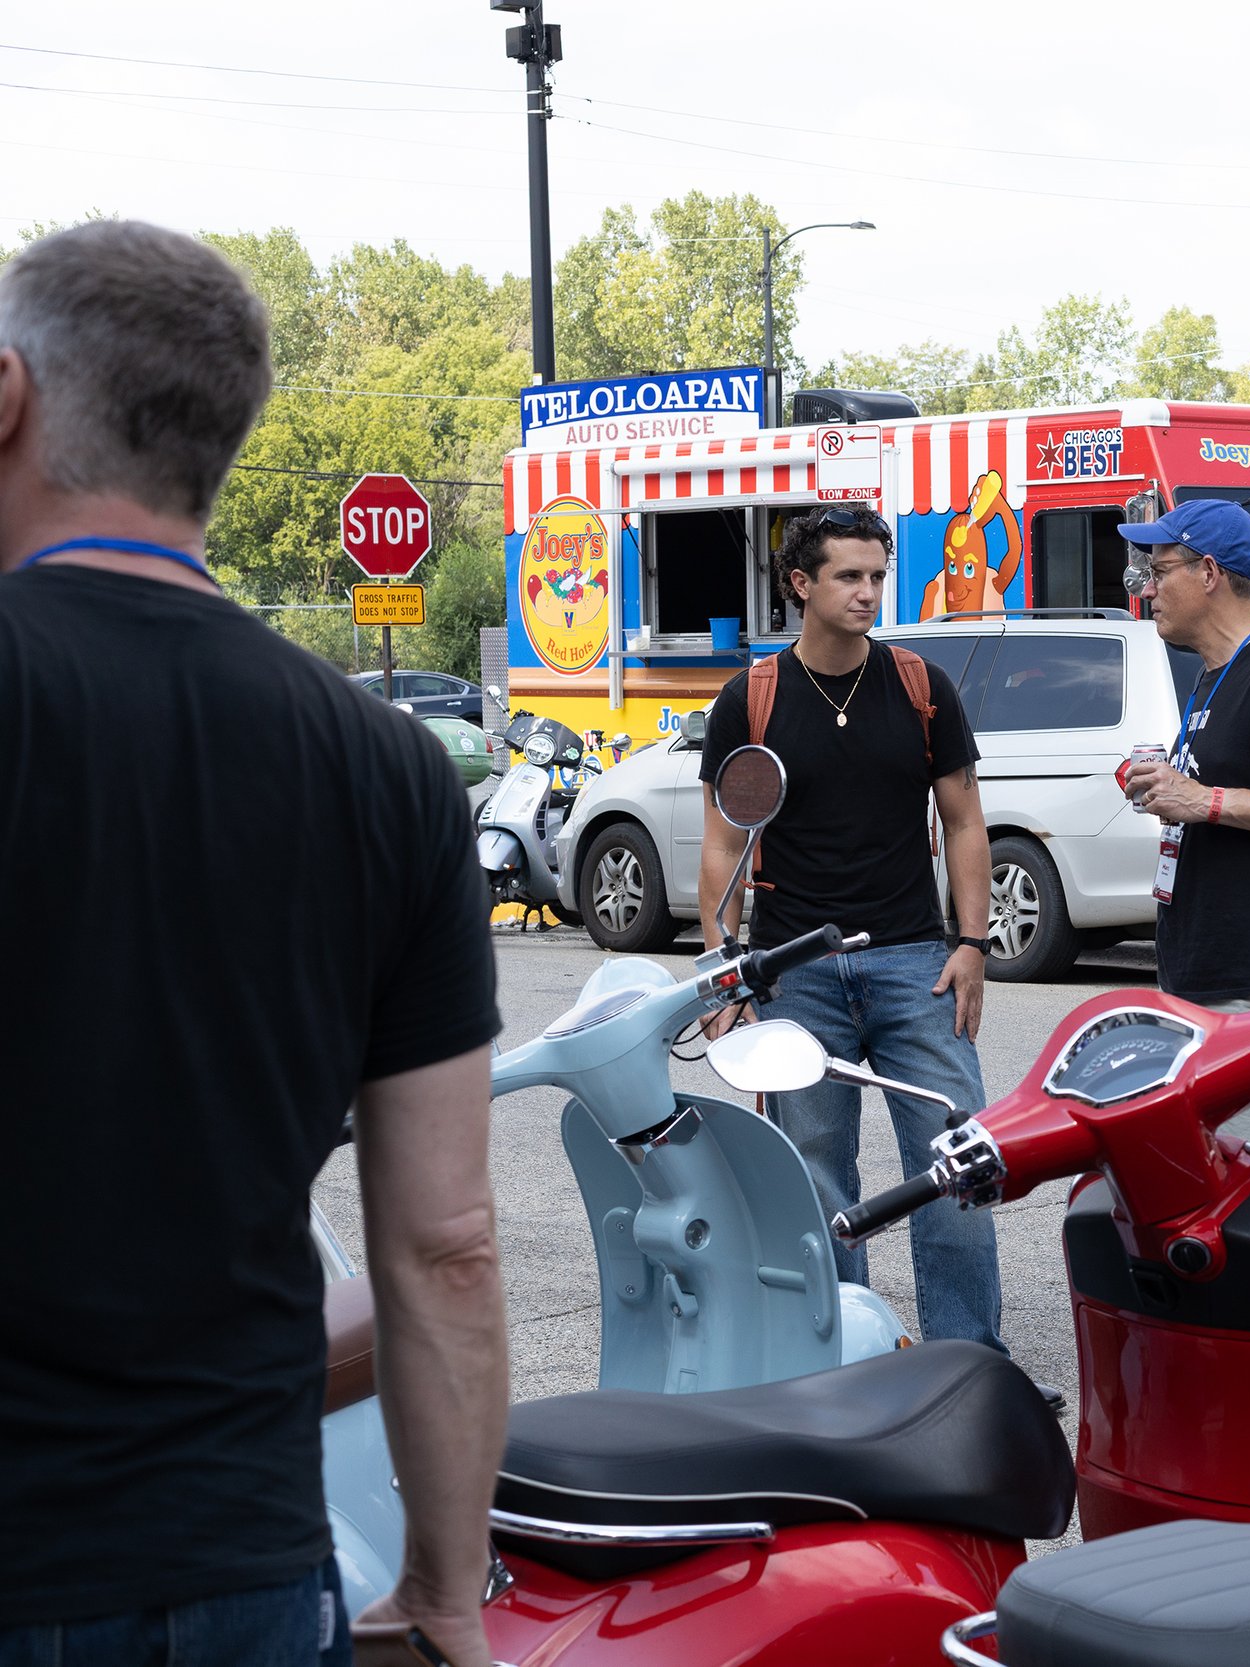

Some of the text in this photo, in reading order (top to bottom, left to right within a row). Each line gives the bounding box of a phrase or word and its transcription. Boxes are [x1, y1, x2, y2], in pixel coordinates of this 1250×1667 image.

[523, 375, 758, 429] TELOLOAPAN
[566, 415, 715, 445] AUTO SERVICE
[1065, 429, 1122, 445] CHICAGO'S
[1064, 444, 1122, 477] BEST
[821, 488, 877, 500] TOW ZONE
[347, 506, 425, 545] STOP
[532, 523, 604, 569] Joey's
[359, 593, 418, 604] CROSS TRAFFIC
[359, 607, 419, 616] DOES NOT STOP
[546, 637, 594, 662] Red Hots
